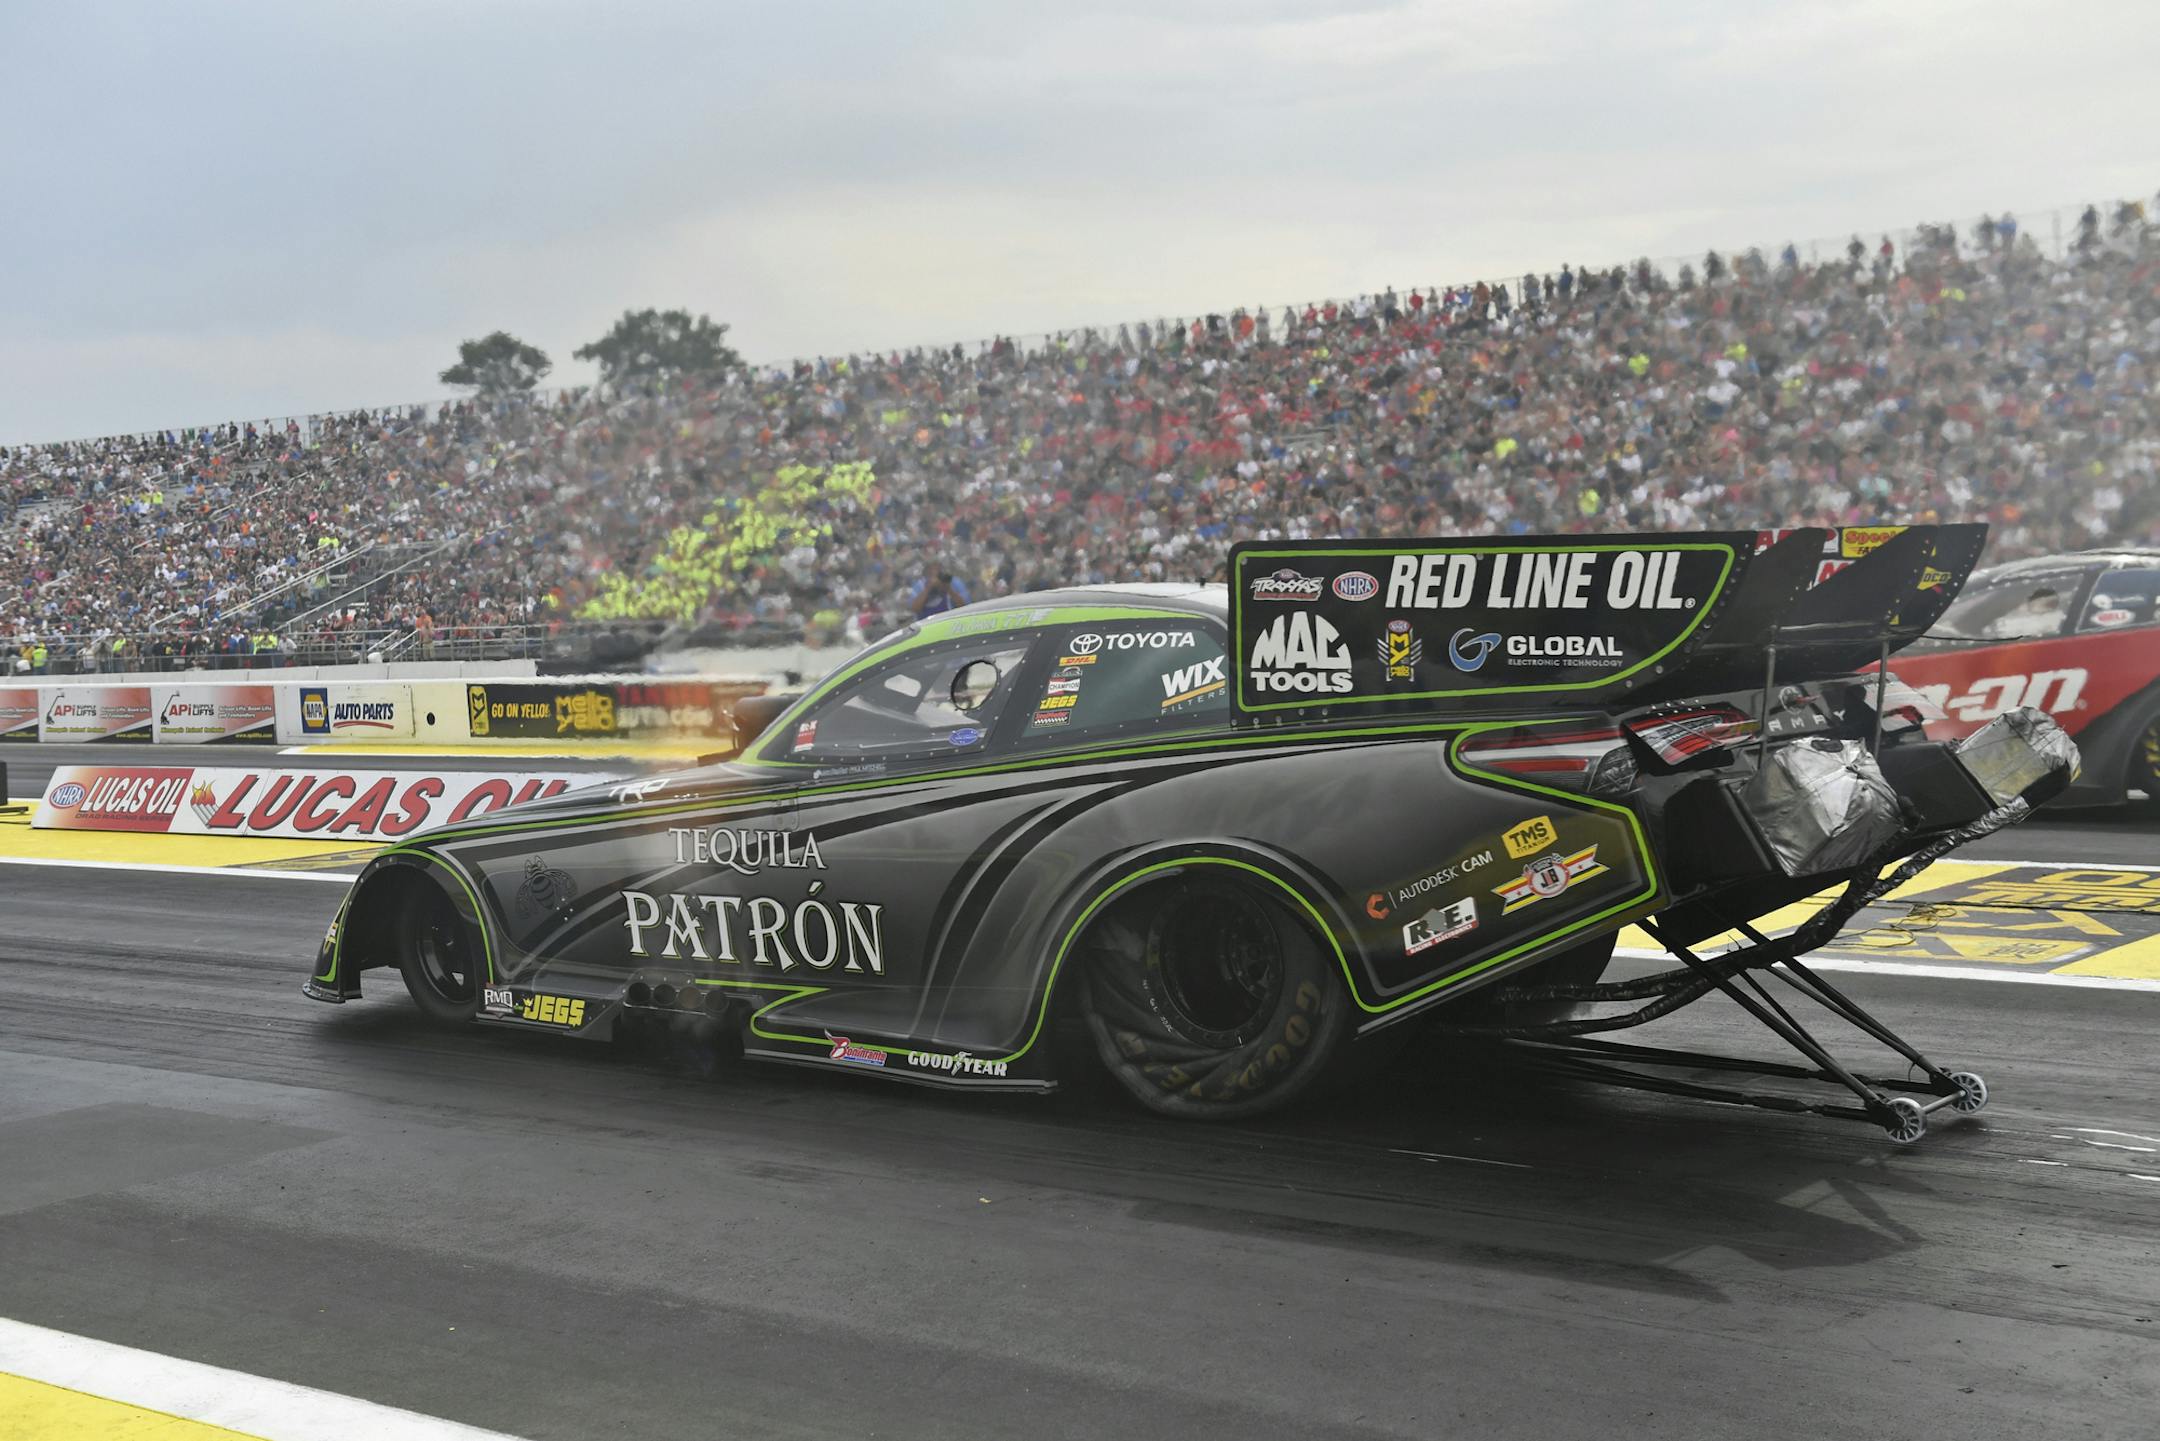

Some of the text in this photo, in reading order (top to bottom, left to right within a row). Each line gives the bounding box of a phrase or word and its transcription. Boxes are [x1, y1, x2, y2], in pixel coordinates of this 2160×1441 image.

[1250, 578, 1321, 593] TRAXXAS
[1340, 577, 1372, 596] NHRA
[1385, 551, 1684, 610] RED LINE OIL
[1105, 632, 1196, 650] TOYOTA
[1250, 611, 1352, 670] MAC
[1507, 635, 1624, 657] GLOBAL
[1508, 658, 1624, 668] ELECTRONIC TECHNOLOGY
[1050, 681, 1080, 690] CHAMPION
[1161, 655, 1226, 698] WIX
[1251, 671, 1353, 693] TOOLS
[192, 708, 215, 716] LIFTS
[306, 702, 323, 719] NAPA
[334, 703, 394, 720] AUTO PARTS
[491, 703, 504, 718] GO
[506, 703, 519, 718] ON
[1039, 695, 1078, 710] JEGS
[1161, 687, 1226, 716] FILTERS
[76, 709, 97, 717] LIFTS
[52, 785, 82, 805] NHRA
[80, 776, 187, 815] LUCAS OIL
[208, 774, 446, 837] LUCAS
[1508, 821, 1549, 848] TMS
[668, 827, 828, 875] TEQUILA
[1399, 850, 1494, 902] AUTODESK CAM
[620, 881, 885, 975] PATRÓN
[522, 994, 586, 1026] JEGS
